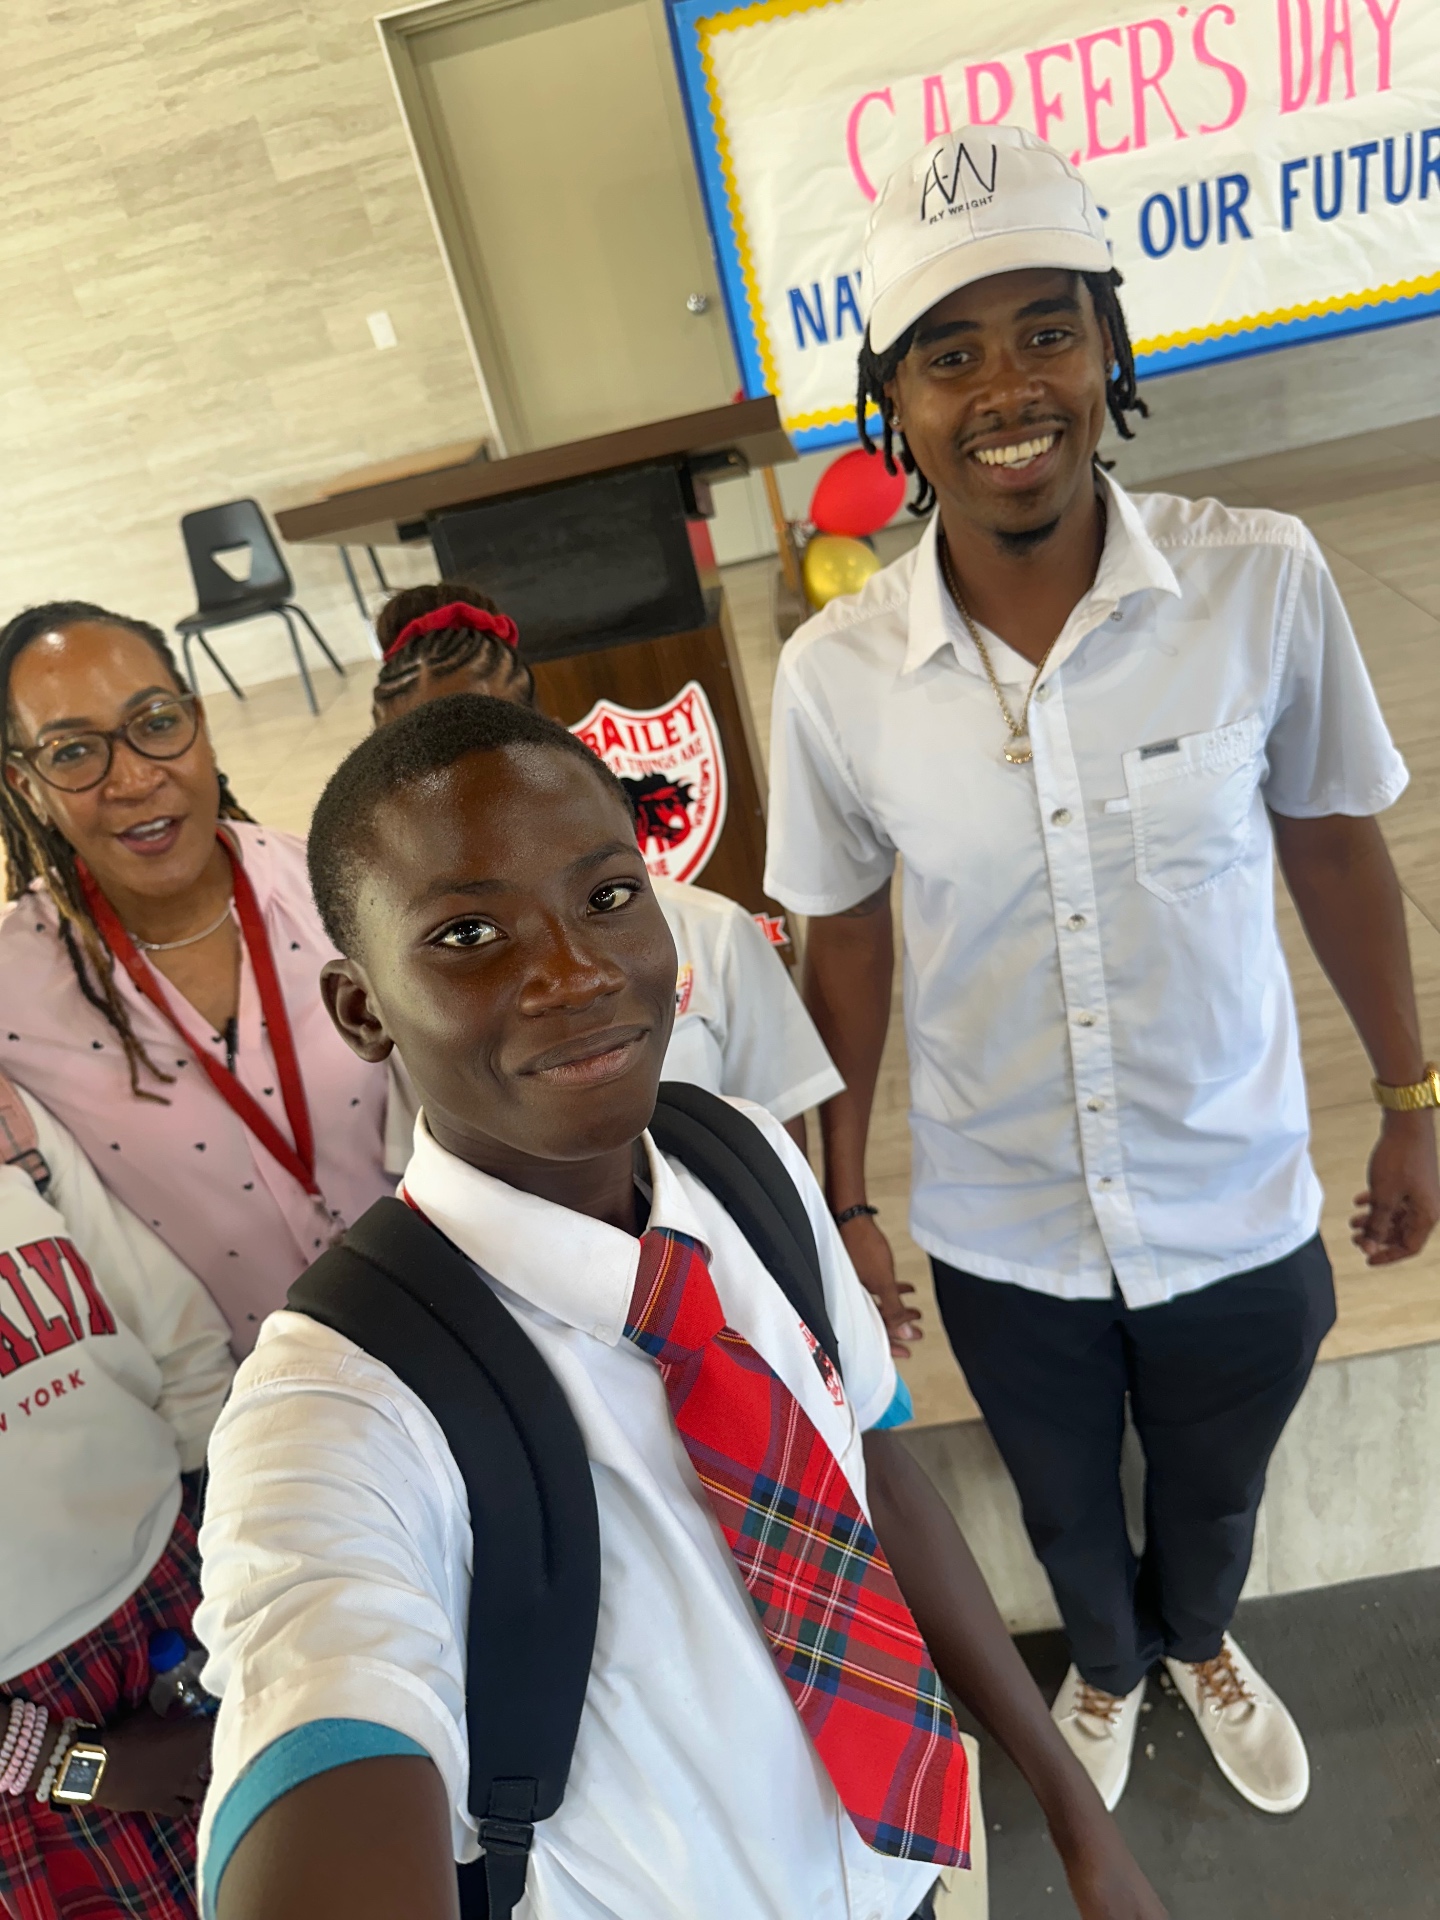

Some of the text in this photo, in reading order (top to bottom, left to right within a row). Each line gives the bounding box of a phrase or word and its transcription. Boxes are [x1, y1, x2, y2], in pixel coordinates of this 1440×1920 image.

[1279, 0, 1401, 116] DAY
[929, 195, 994, 225] FLY WRIGHT
[1139, 173, 1253, 260] OUR
[1281, 127, 1440, 232] FUTUR
[18, 1369, 86, 1417] YORK
